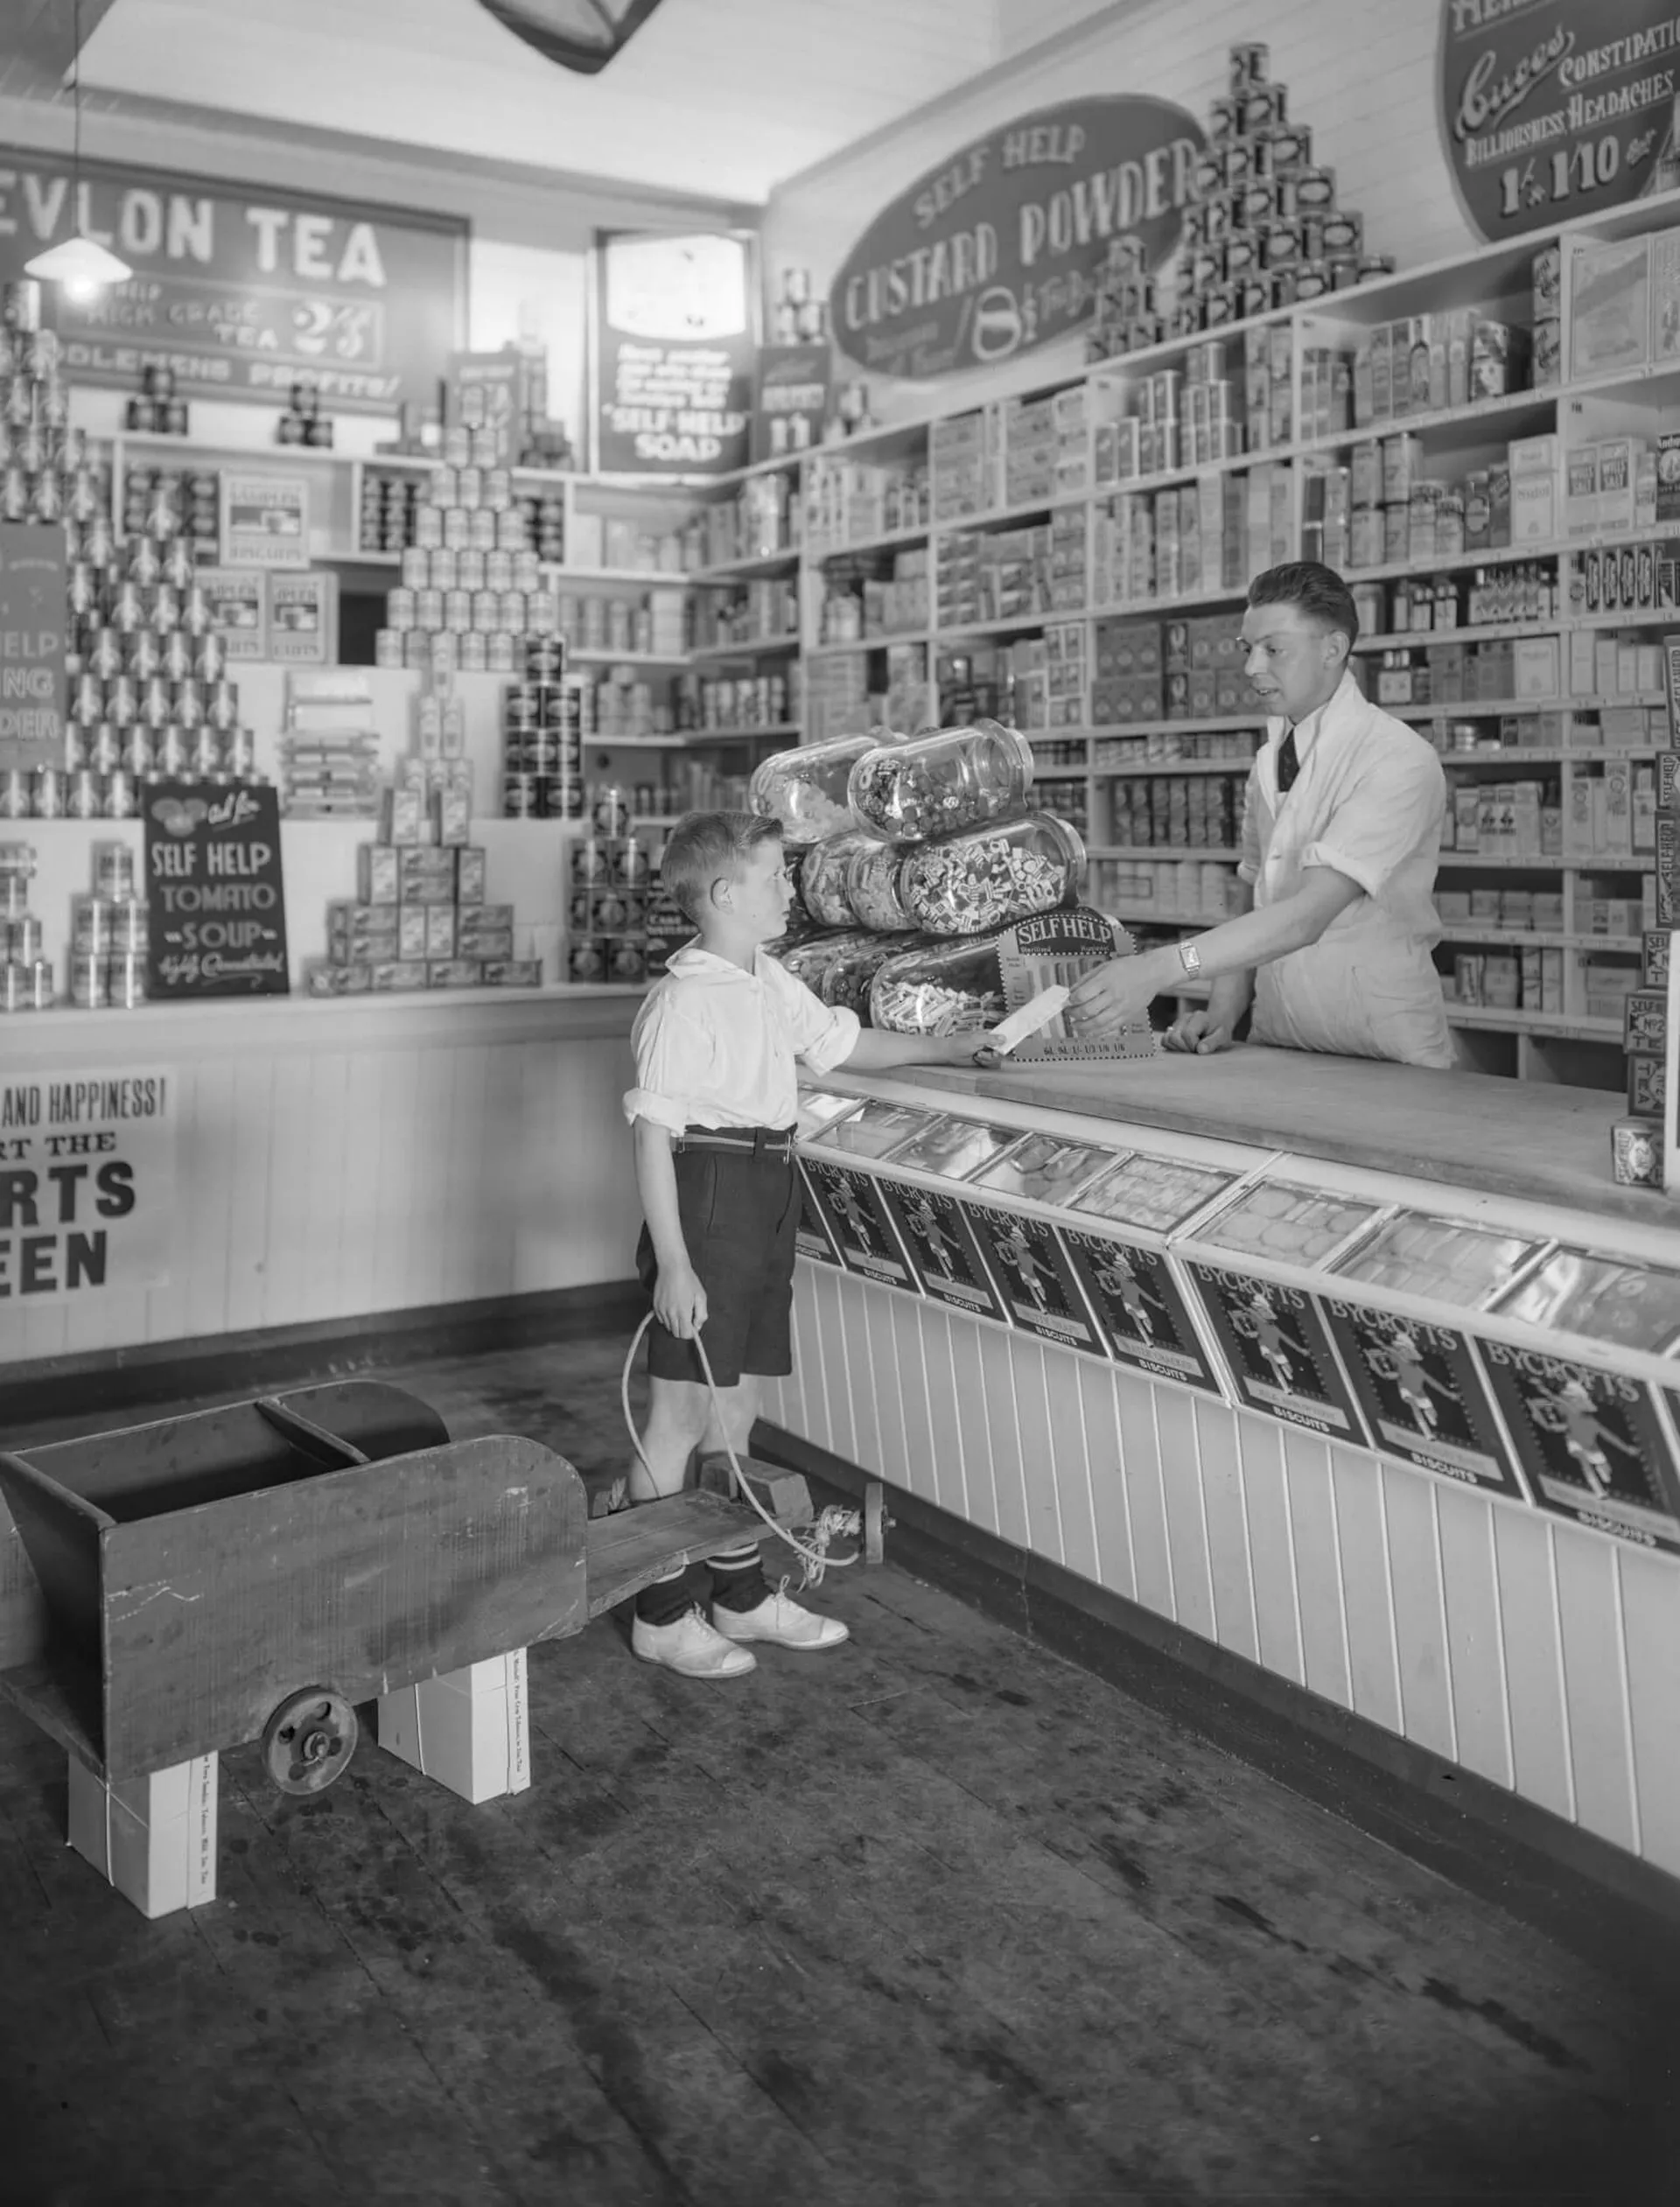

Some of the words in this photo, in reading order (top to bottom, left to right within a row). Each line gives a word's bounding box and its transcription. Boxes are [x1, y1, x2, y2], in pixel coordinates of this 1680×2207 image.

[1569, 69, 1675, 130] HEADACHES
[914, 146, 990, 229] SELF
[1004, 124, 1086, 169] HELP
[246, 206, 386, 287] TEA
[846, 223, 998, 331] CUSTARD
[1020, 137, 1202, 265] POWDER
[0, 631, 59, 658] ELP
[151, 841, 198, 876] SELF
[206, 840, 271, 876] HELP
[160, 882, 277, 913] TOMATO
[1018, 918, 1061, 944] SELF
[1061, 917, 1113, 943] HELP
[2, 1086, 40, 1128] AND
[49, 1077, 165, 1124] HAPPINESS!
[1637, 1063, 1651, 1104] TEA
[46, 1132, 116, 1157] THE
